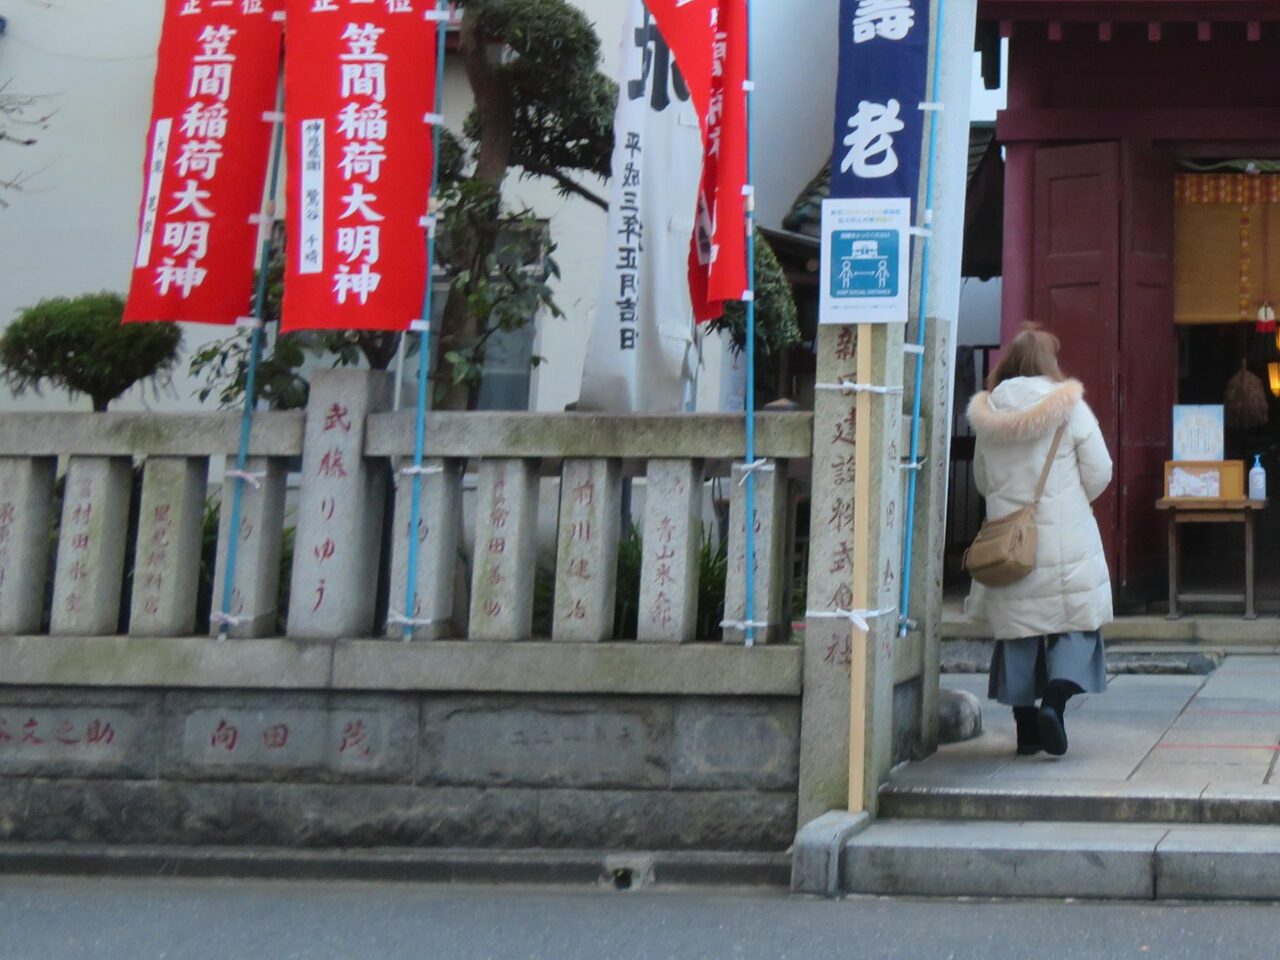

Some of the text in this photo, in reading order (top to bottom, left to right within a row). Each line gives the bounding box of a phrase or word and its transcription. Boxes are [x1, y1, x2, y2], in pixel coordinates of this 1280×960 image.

[153, 23, 237, 300] 笠間稲荷大明神
[331, 22, 389, 306] 笠間稲荷大明神
